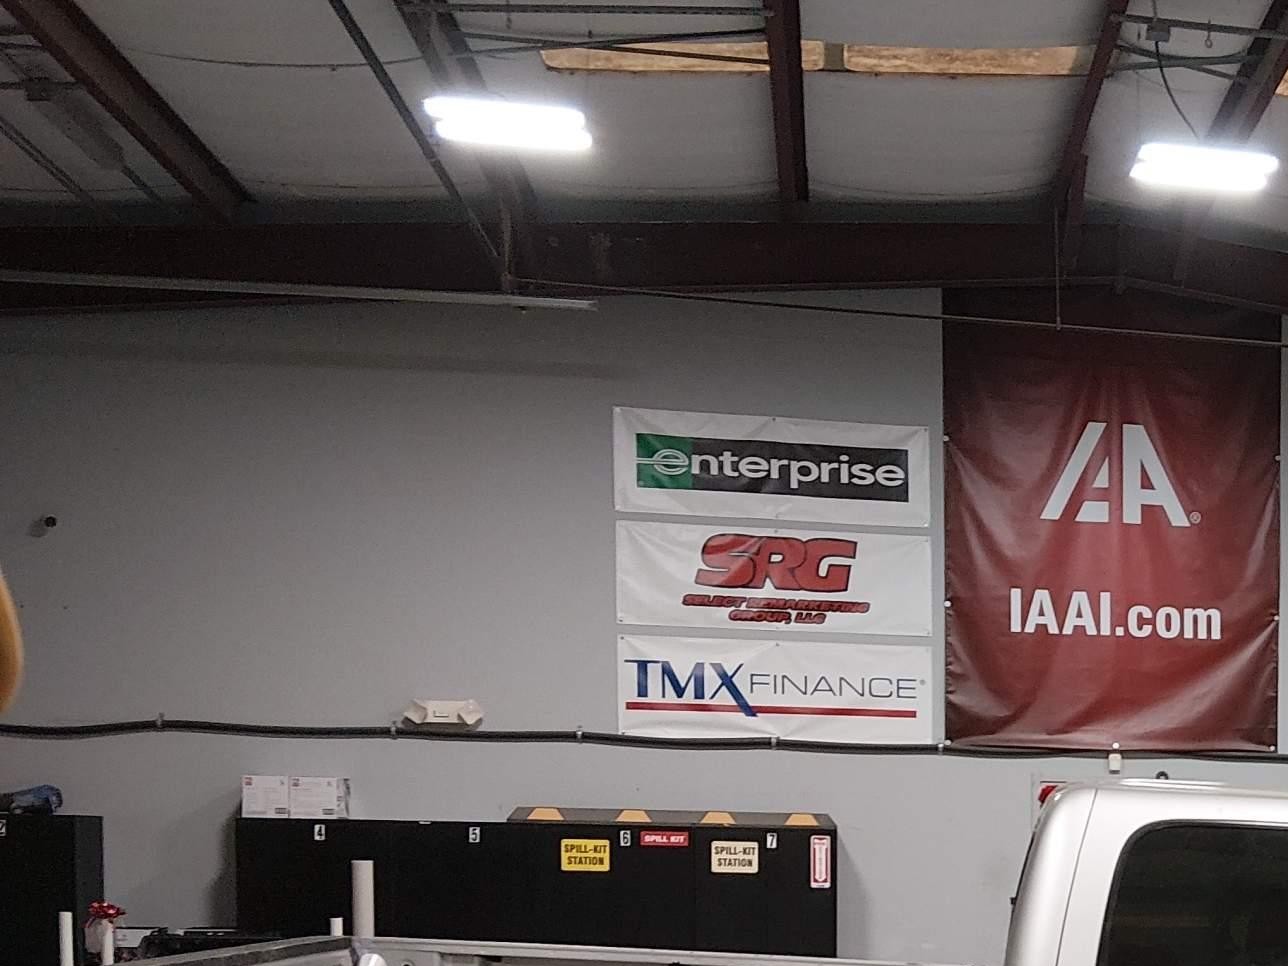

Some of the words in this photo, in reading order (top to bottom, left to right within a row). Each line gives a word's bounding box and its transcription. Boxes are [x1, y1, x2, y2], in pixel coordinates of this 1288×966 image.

[647, 447, 906, 490] enterprise
[694, 533, 858, 593] SRG
[1009, 587, 1222, 640] IAAI.com
[623, 659, 758, 717] TMX
[749, 673, 918, 699] FINANCE
[315, 826, 325, 839] 4
[470, 827, 479, 842] 5
[621, 831, 630, 845] 6
[644, 834, 669, 843] SPILL
[670, 835, 686, 843] KIT
[769, 833, 776, 848] 7
[563, 843, 608, 854] SPILL-KIT
[714, 845, 756, 856] SPILL-KIT
[566, 855, 605, 866] STATION
[717, 857, 753, 867] STATION
